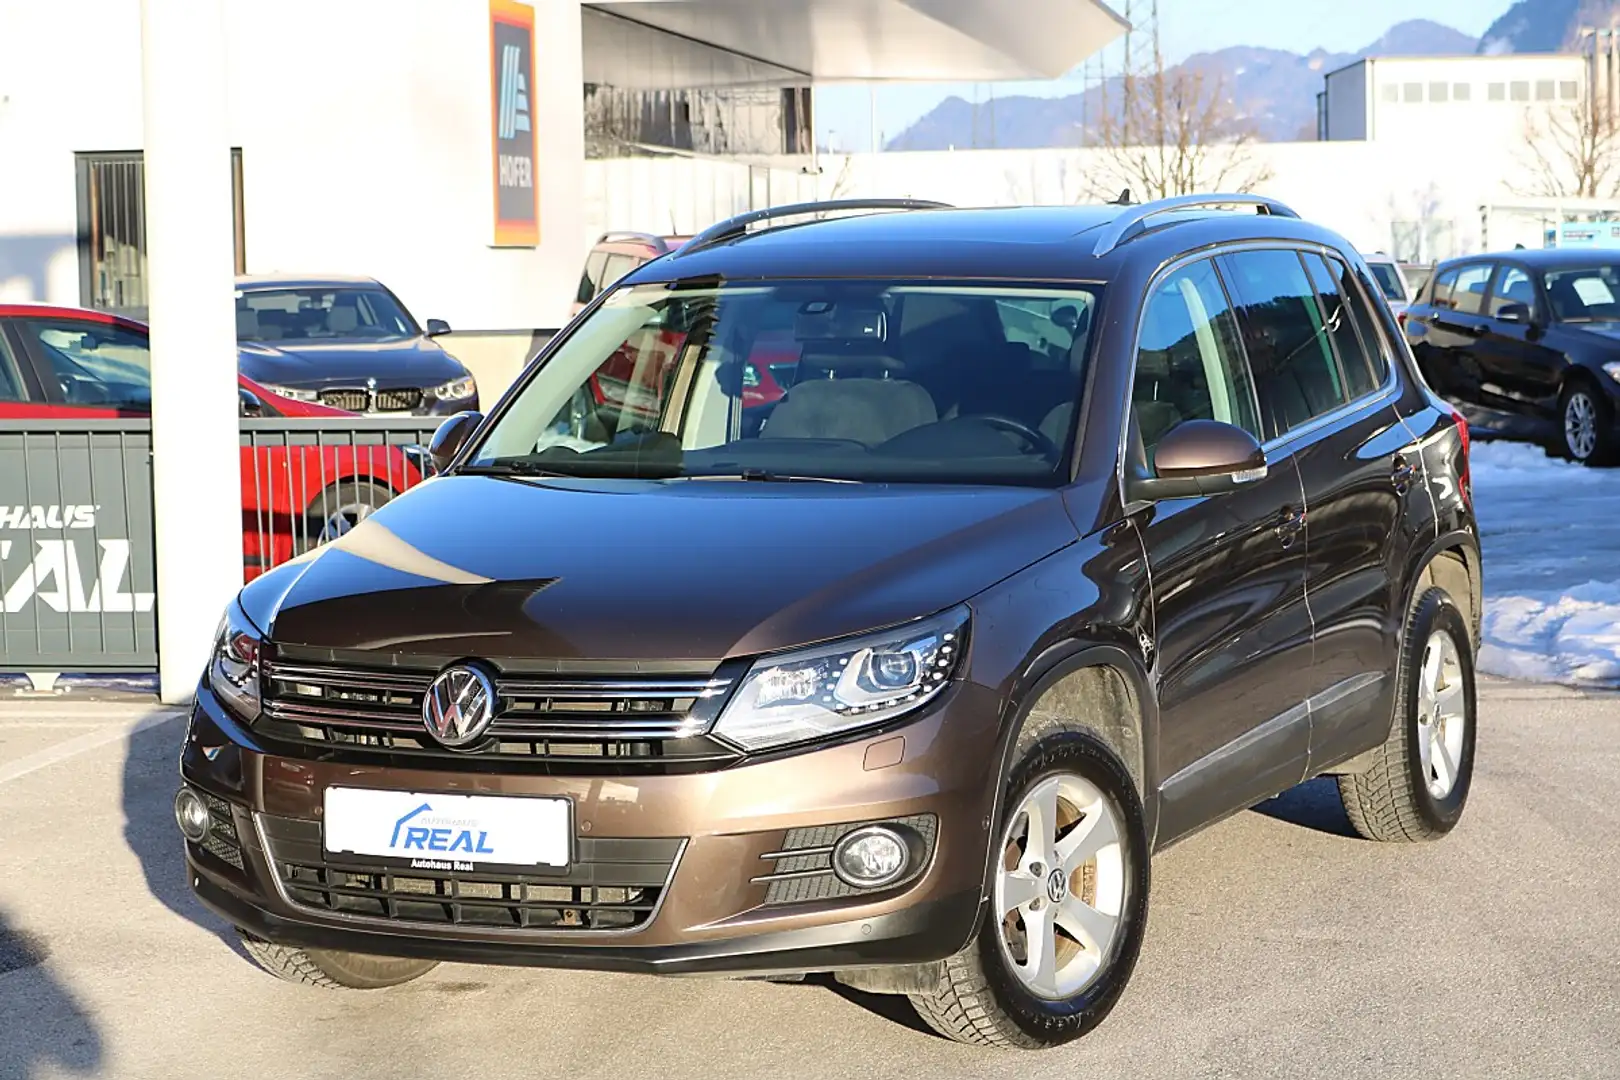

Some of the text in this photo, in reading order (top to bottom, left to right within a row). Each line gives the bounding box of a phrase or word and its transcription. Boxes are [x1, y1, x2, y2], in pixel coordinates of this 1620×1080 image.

[499, 154, 533, 187] HOFER
[0, 539, 155, 612] AL
[403, 827, 494, 854] REAL
[411, 858, 474, 871] Autohaus Real
